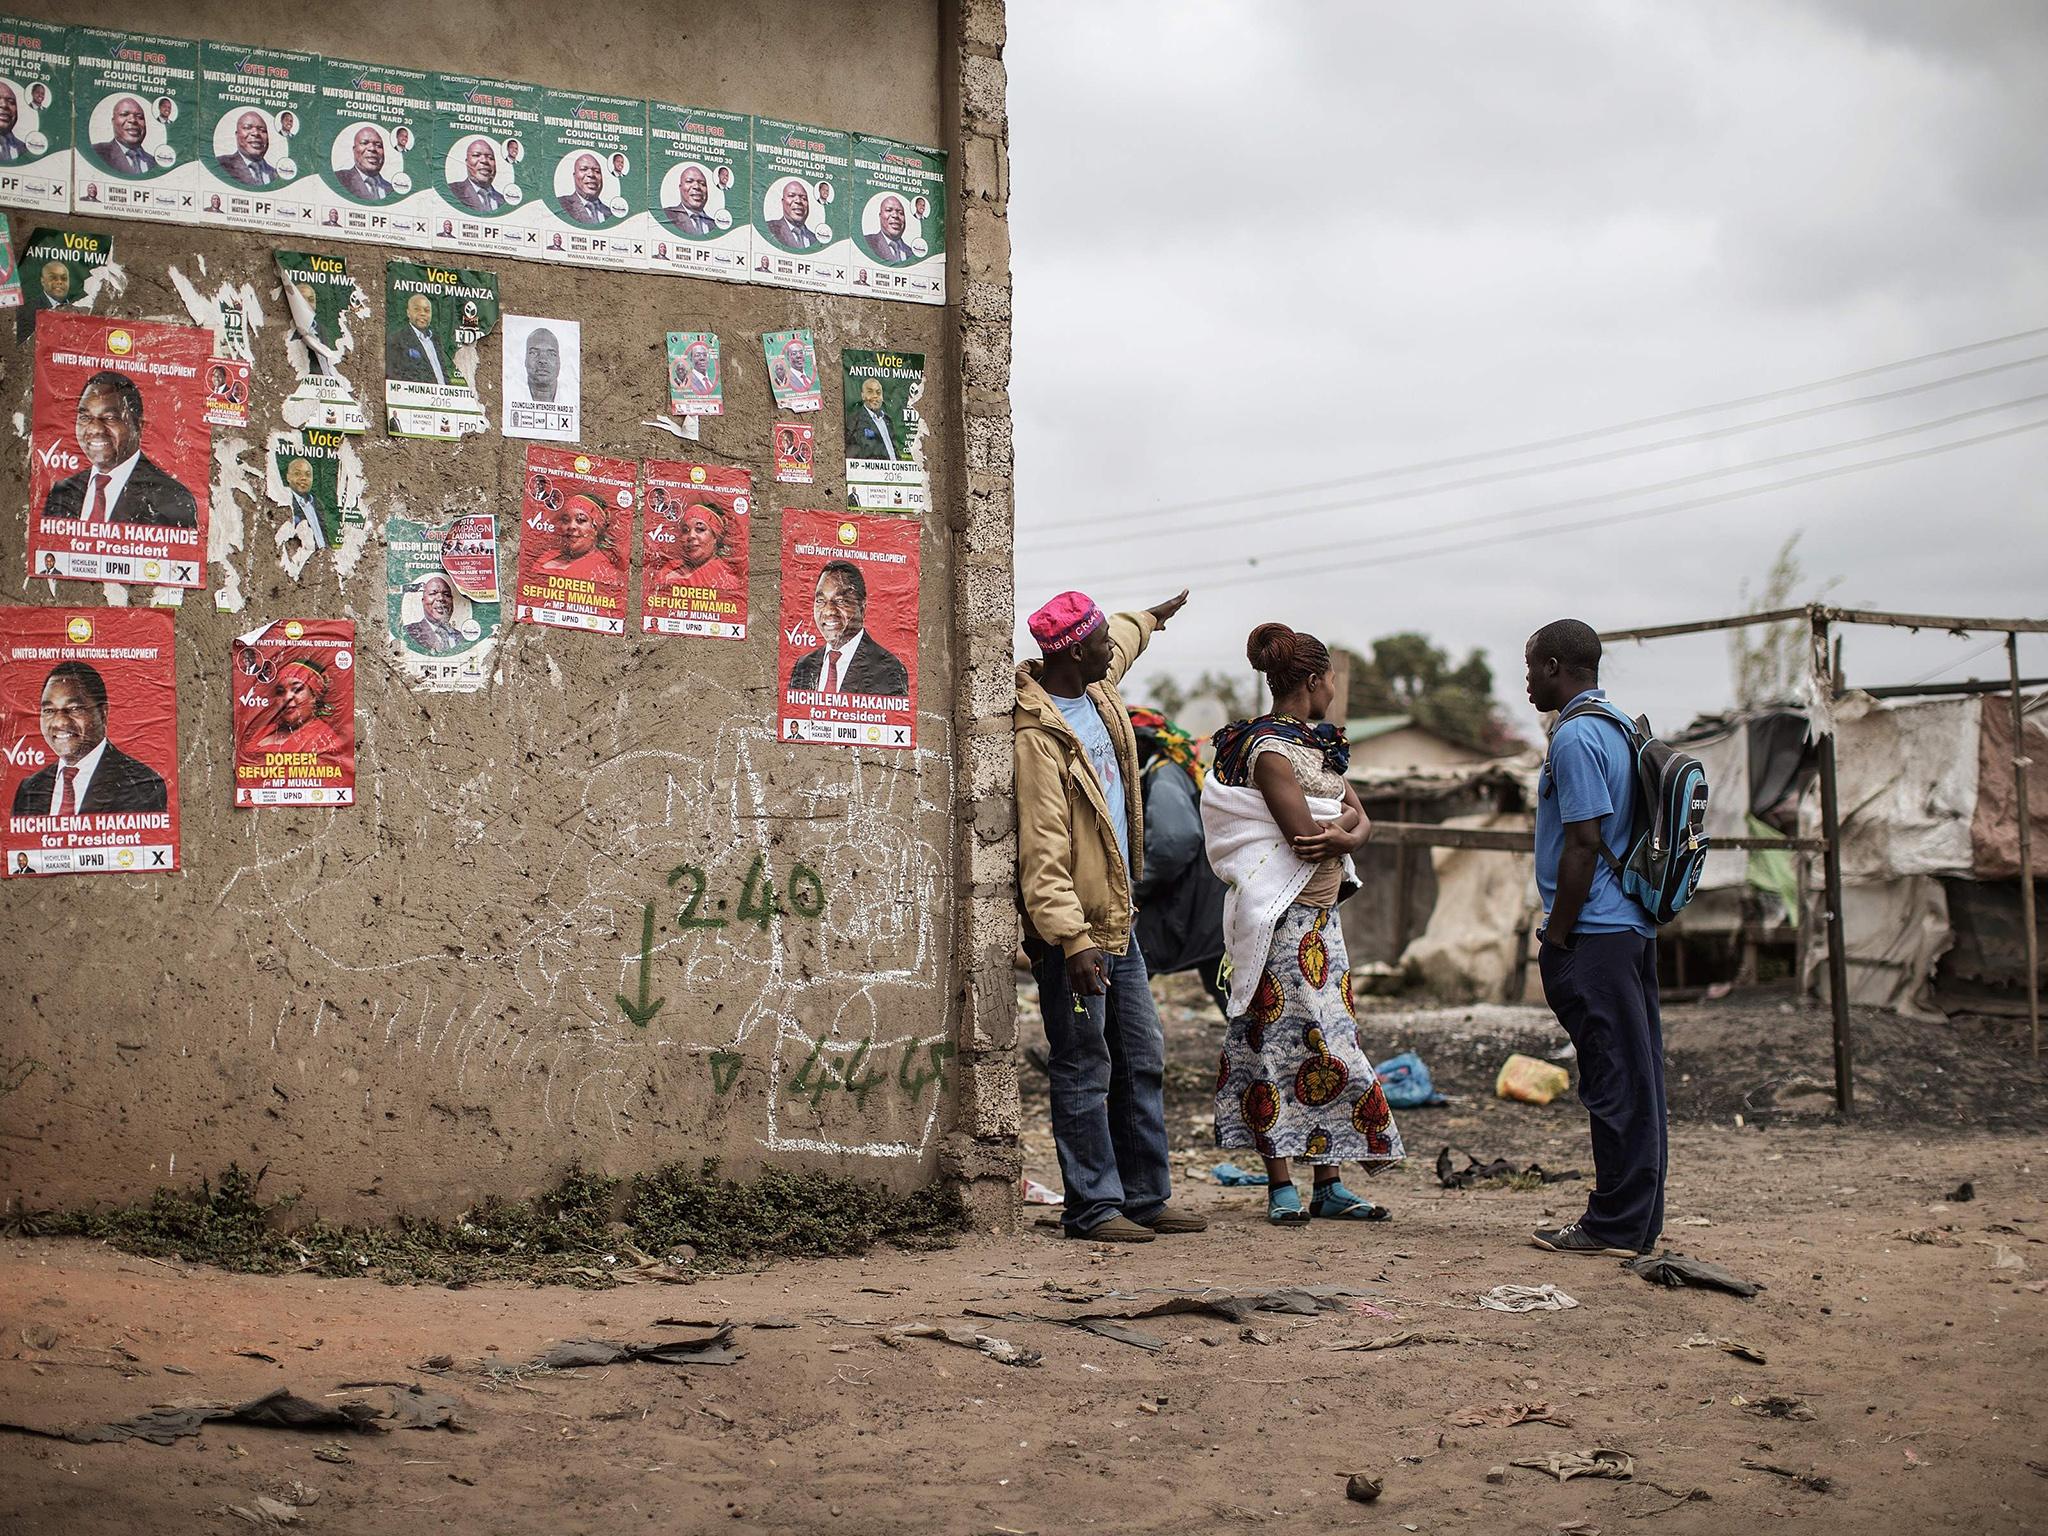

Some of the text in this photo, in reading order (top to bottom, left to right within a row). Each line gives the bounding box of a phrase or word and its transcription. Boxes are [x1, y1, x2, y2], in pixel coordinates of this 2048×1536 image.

[21, 49, 70, 65] CHIPEMBELE
[144, 51, 166, 64] FOR
[14, 69, 38, 79] WARD
[78, 55, 194, 79] WATSON MTONGA CHIPEMBELE
[103, 70, 166, 85] COUNCILLOR
[203, 70, 316, 94] WATSON MTONGA CHIPEMBELE
[94, 78, 175, 95] MTENDERE WARD 30
[228, 84, 288, 99] COUNCILLOR
[218, 92, 297, 109] MTENDERE WARD 30
[322, 86, 430, 110] WATSON MTONGA CHIPEMBELE
[345, 100, 404, 115] COUNCILLOR
[458, 113, 514, 127] COUNCILLOR
[565, 128, 619, 142] COUNCILLOR
[672, 141, 724, 155] COUNCILLOR
[775, 156, 825, 171] COUNCILLOR
[2, 177, 19, 190] PF
[873, 171, 921, 186] COUNCILLOR
[133, 190, 191, 206] PF X
[255, 202, 311, 218] PF X
[64, 233, 98, 250] Vote
[26, 246, 80, 262] ANTONIO
[310, 256, 342, 273] Vote
[285, 270, 326, 283] NTONIO
[427, 268, 458, 284] Vote
[394, 280, 494, 299] ANTONIO MWANZA
[52, 352, 196, 378] UNITED PARTY FOR NATIONAL DEVELOPMENT
[877, 353, 902, 367] Vote
[849, 367, 889, 378] ANTONIO
[316, 388, 336, 399] 2016
[431, 398, 451, 407] 2016
[562, 418, 568, 428] X
[309, 431, 339, 447] Vote
[38, 439, 79, 470] Vote
[850, 461, 859, 469] MP
[528, 465, 546, 474] UNITED
[547, 468, 563, 476] PARTY
[574, 472, 598, 482] NATIONAL
[598, 477, 633, 488] DEVELOPMENT
[884, 472, 902, 481] 2016
[526, 509, 556, 533] Vote
[40, 518, 198, 544] HICHILEMA HAKAINDE
[648, 522, 675, 543] Vote
[70, 538, 168, 558] for President
[391, 542, 420, 551] WATSON
[795, 544, 906, 564] UNITED PARTY FOR NATIONAL DEVELOPMENT
[105, 562, 191, 581] UPND X
[548, 576, 594, 593] DOREEN
[671, 585, 716, 600] DOREEN
[522, 584, 616, 608] SEFUKE MWAMBA
[552, 600, 564, 610] MP
[566, 602, 597, 614] MUNALI
[647, 595, 737, 614] SEFUKE MWAMBA
[561, 614, 579, 623] UPND
[609, 620, 618, 630] X
[676, 610, 688, 618] MP
[690, 611, 719, 621] MUNALI
[686, 623, 702, 631] UPND
[732, 625, 740, 635] X
[785, 620, 816, 646] Vote
[12, 647, 158, 660] UNITED PARTY FOR NATIONAL DEVELOPMENT
[443, 667, 458, 677] PF
[237, 686, 269, 707] Vote
[786, 690, 909, 711] HICHILEMA HAKAINDE
[810, 707, 886, 723] for President
[837, 728, 904, 743] UPND X
[0, 735, 44, 765] Vote
[266, 753, 317, 765] DOREEN
[238, 766, 341, 778] SEFUKE MWAMBA
[272, 778, 285, 787] MP
[288, 778, 321, 787] MUNALI
[336, 790, 345, 800] X
[9, 812, 169, 833] HICHILEMA HAKAINDE
[41, 831, 141, 847] for President
[78, 850, 164, 866] UPND X
